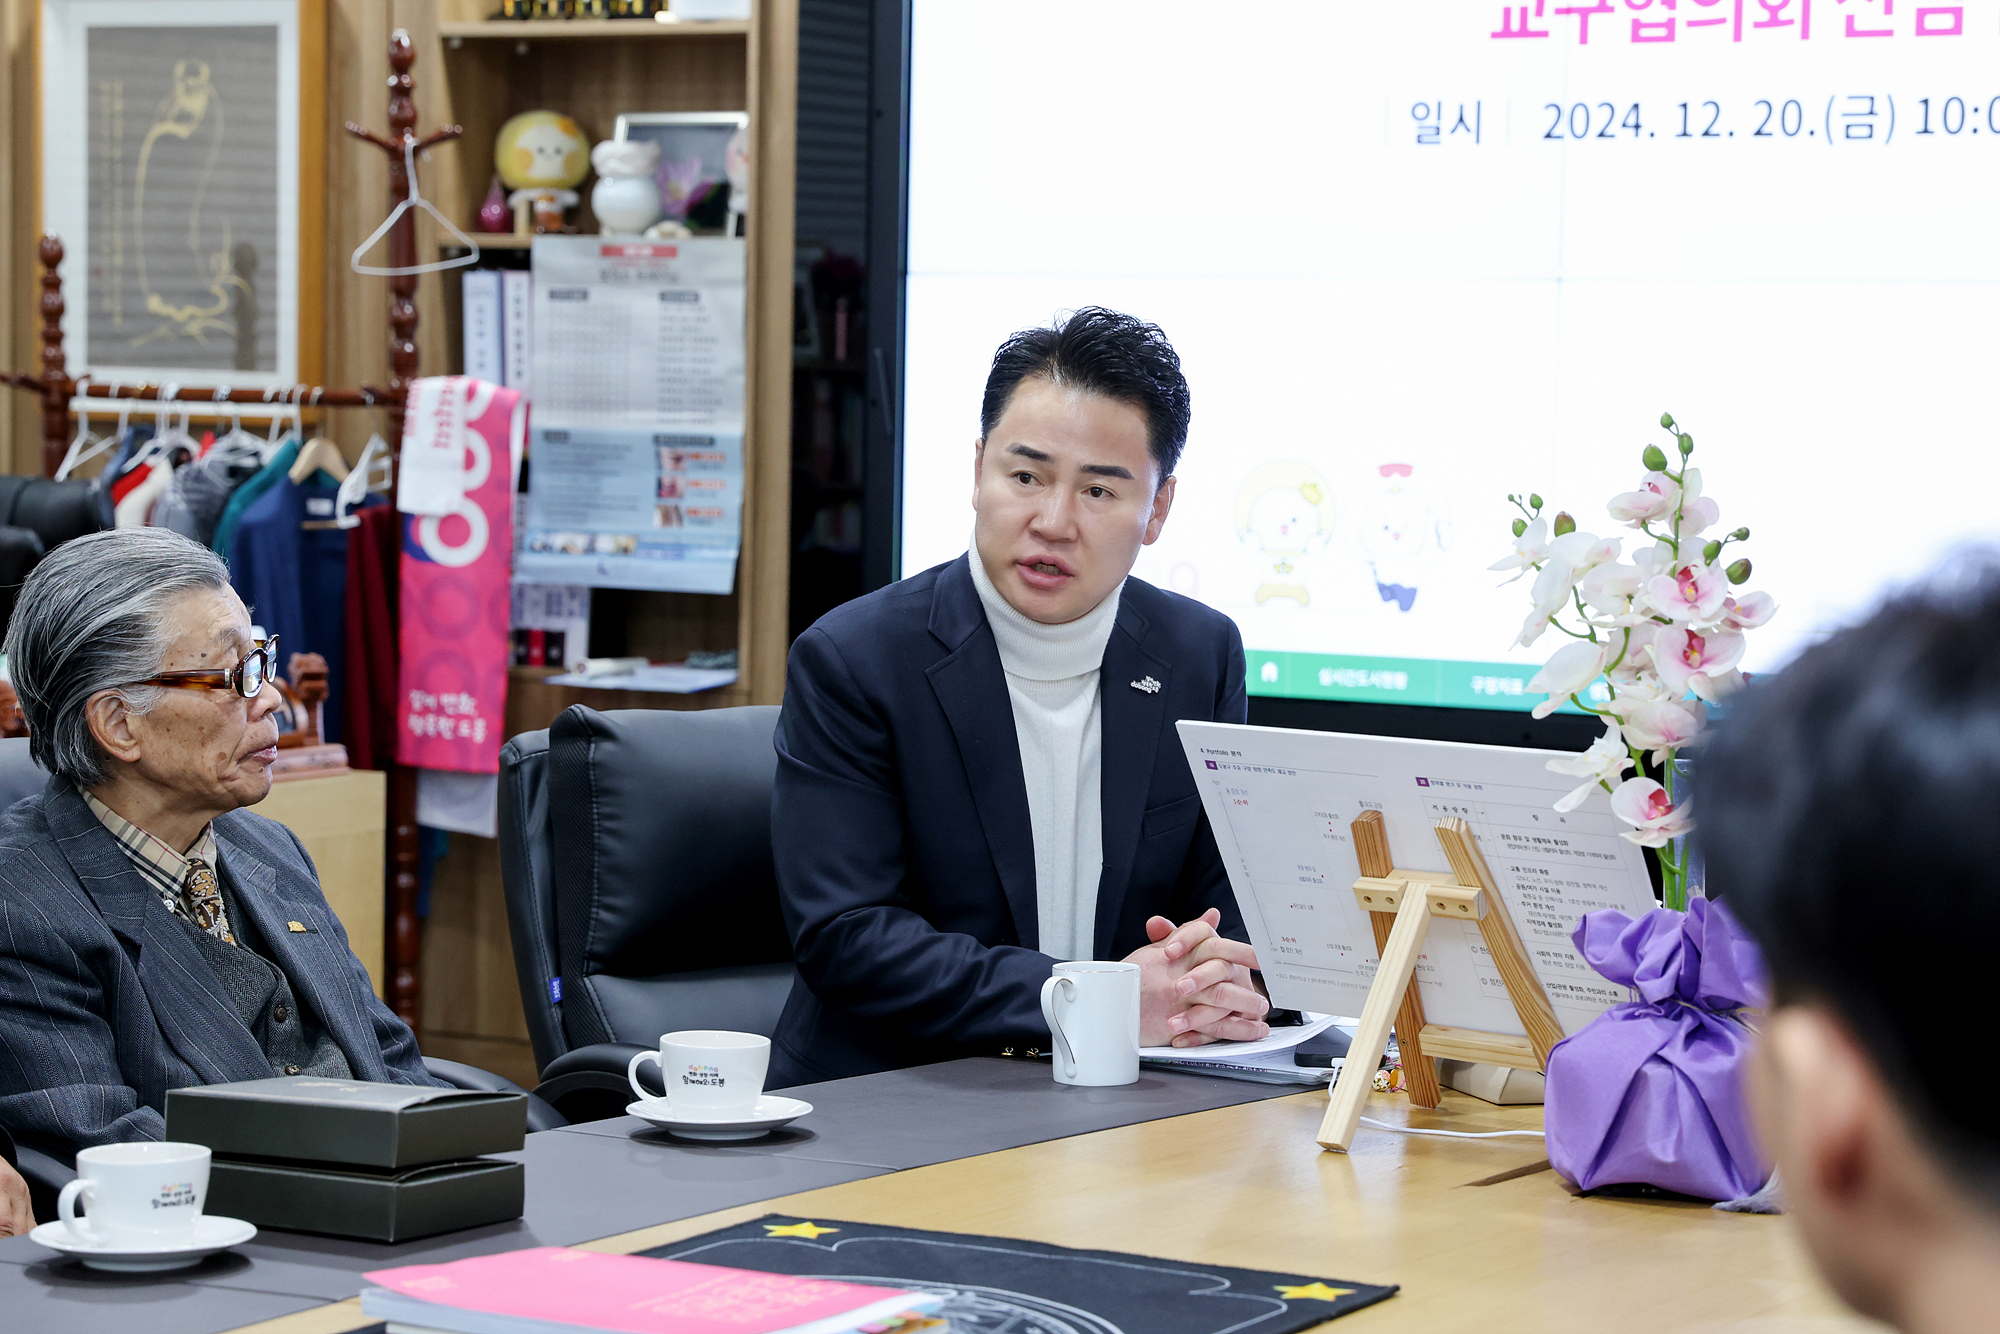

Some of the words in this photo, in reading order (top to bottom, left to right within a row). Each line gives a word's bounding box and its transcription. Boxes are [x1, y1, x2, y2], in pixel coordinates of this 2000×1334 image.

[1411, 100, 1482, 144] 일시
[1543, 102, 1656, 140] 2024.
[1676, 100, 1736, 139] 12.
[1753, 94, 1896, 145] 20.(금)
[711, 1078, 724, 1087] 도봉
